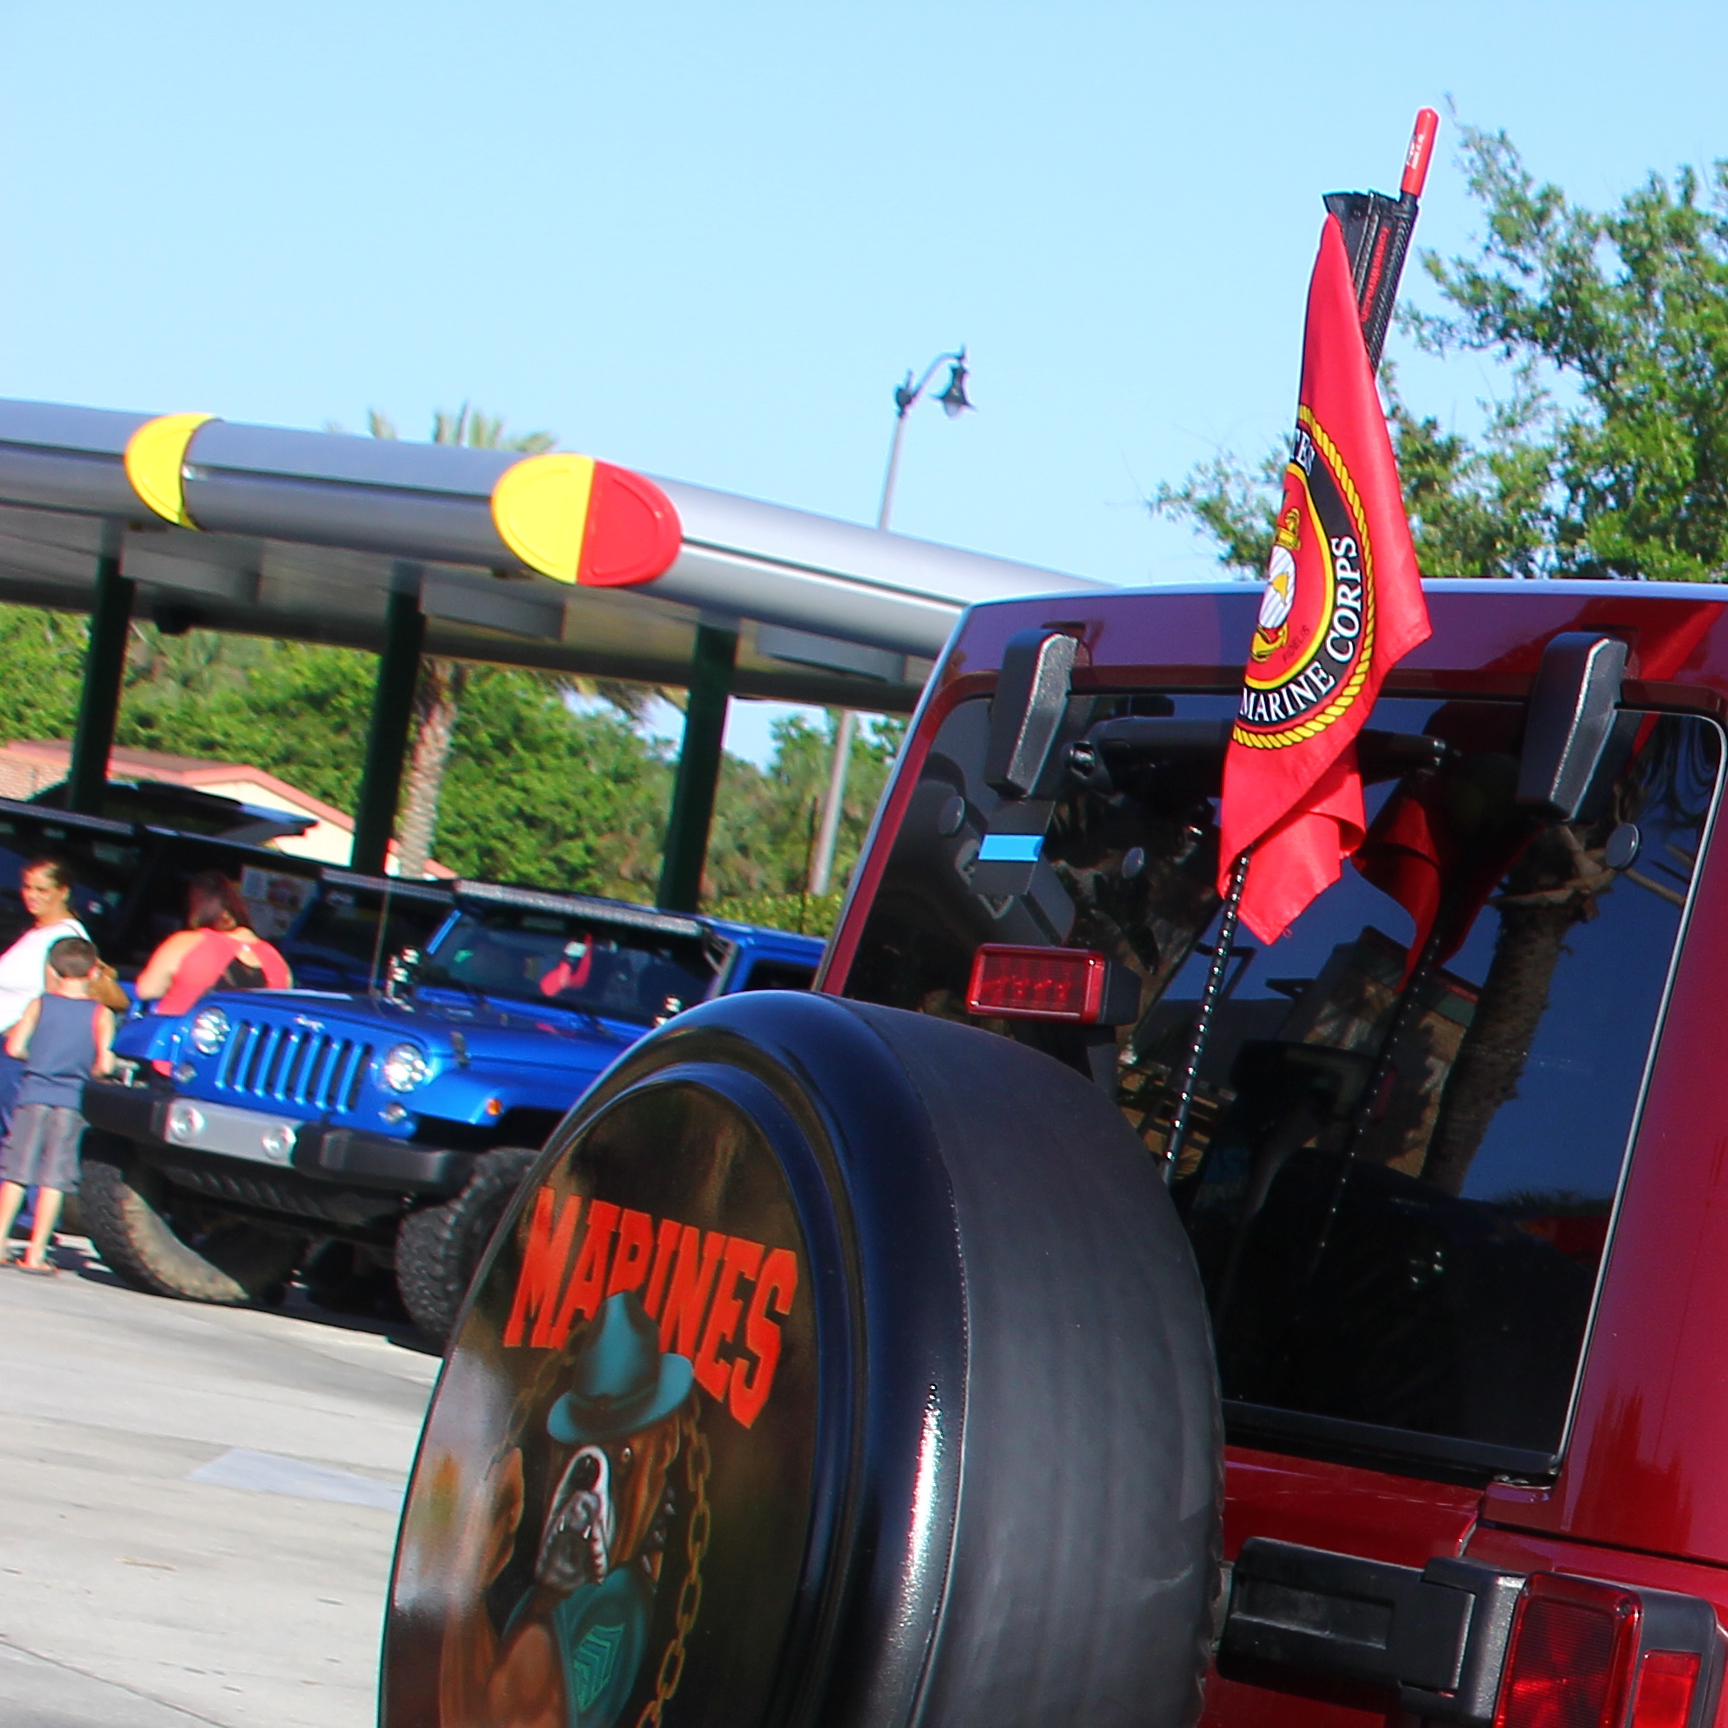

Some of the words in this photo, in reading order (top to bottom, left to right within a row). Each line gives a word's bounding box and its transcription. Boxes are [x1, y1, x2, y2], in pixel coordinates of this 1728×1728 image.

[1239, 660, 1336, 723] MARINE
[1325, 535, 1363, 664] CORPS
[502, 1185, 798, 1430] MARINES
